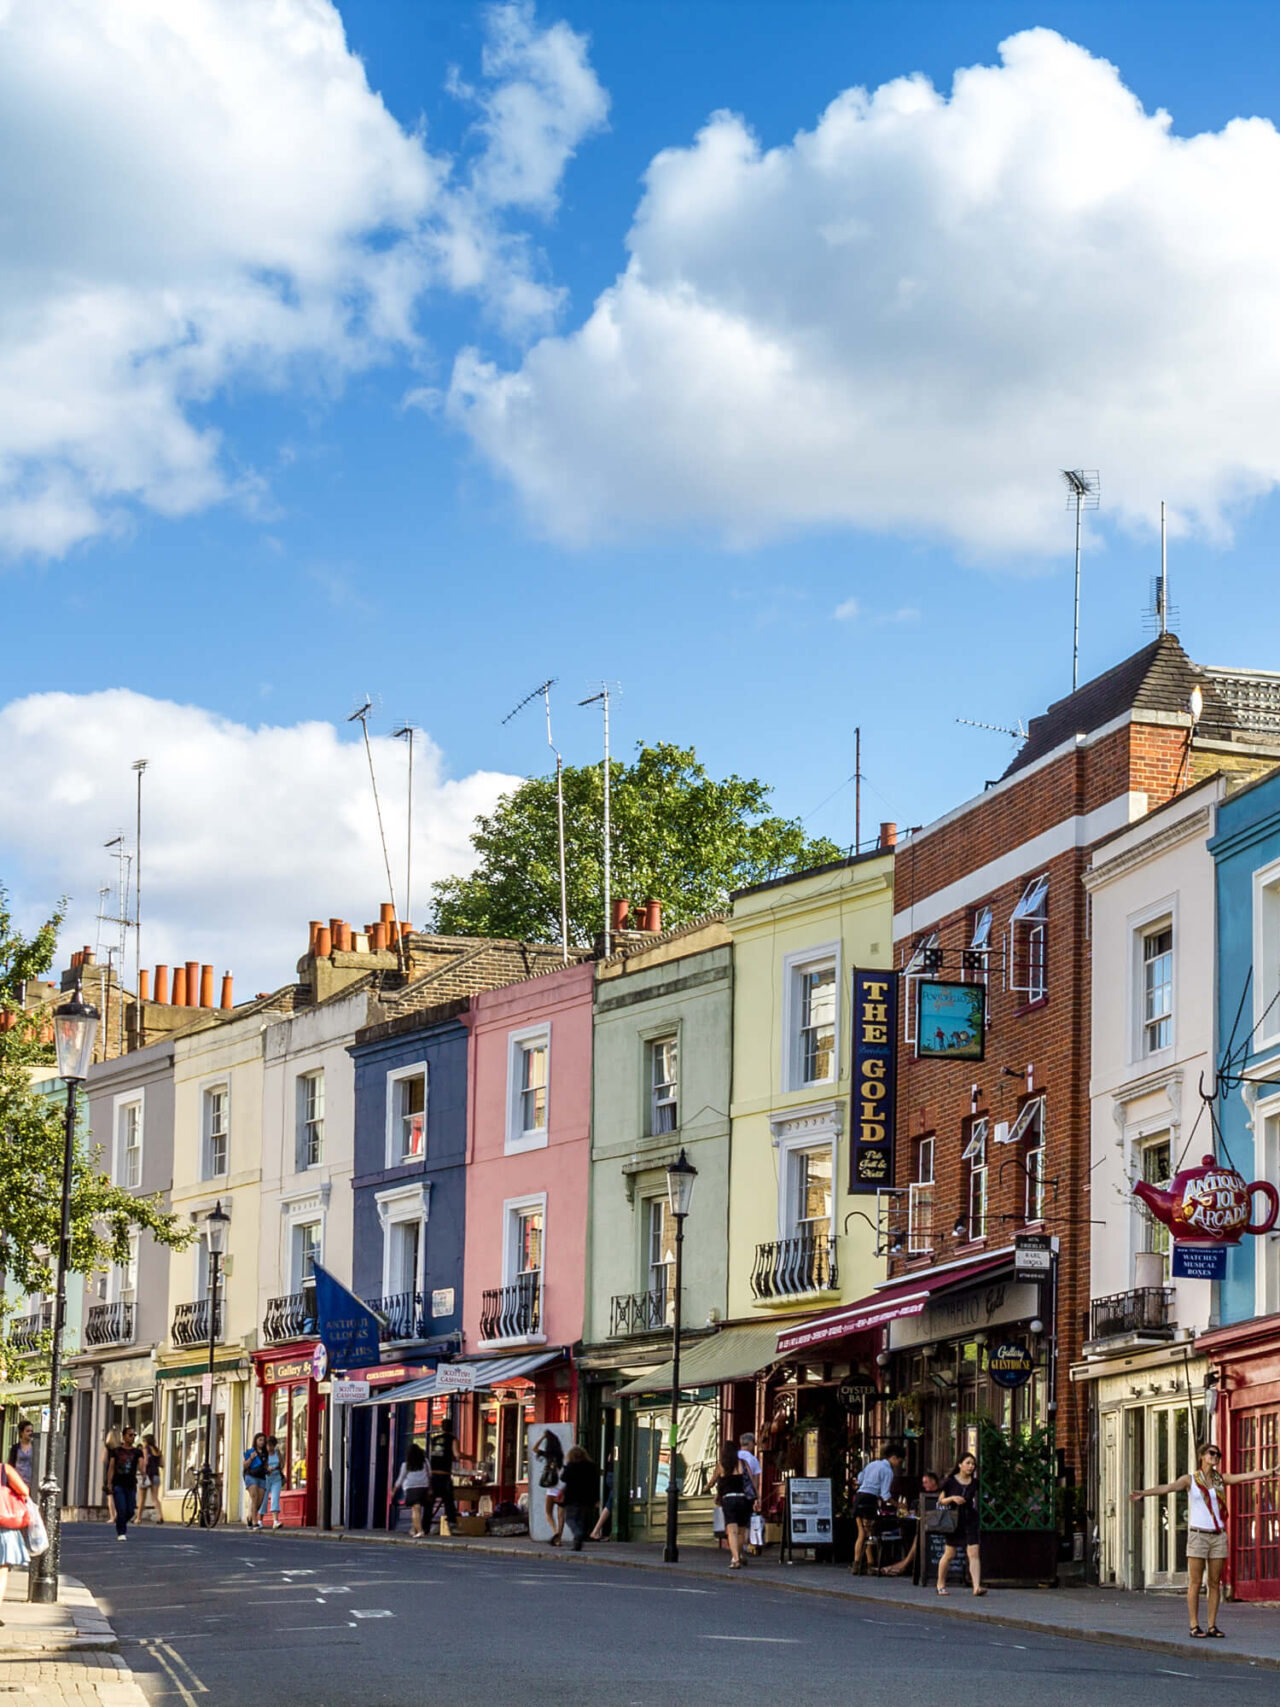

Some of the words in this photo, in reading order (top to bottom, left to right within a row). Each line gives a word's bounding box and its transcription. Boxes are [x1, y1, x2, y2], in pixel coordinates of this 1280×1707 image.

[862, 981, 888, 1043] THE
[860, 1059, 886, 1142] GOLD
[1216, 1191, 1234, 1208] 101
[1187, 1201, 1248, 1227] ARCADE
[1183, 1261, 1217, 1269] MUSICAL
[278, 1365, 302, 1377] Gallery
[841, 1385, 876, 1395] OYSTER
[848, 1395, 865, 1403] BA
